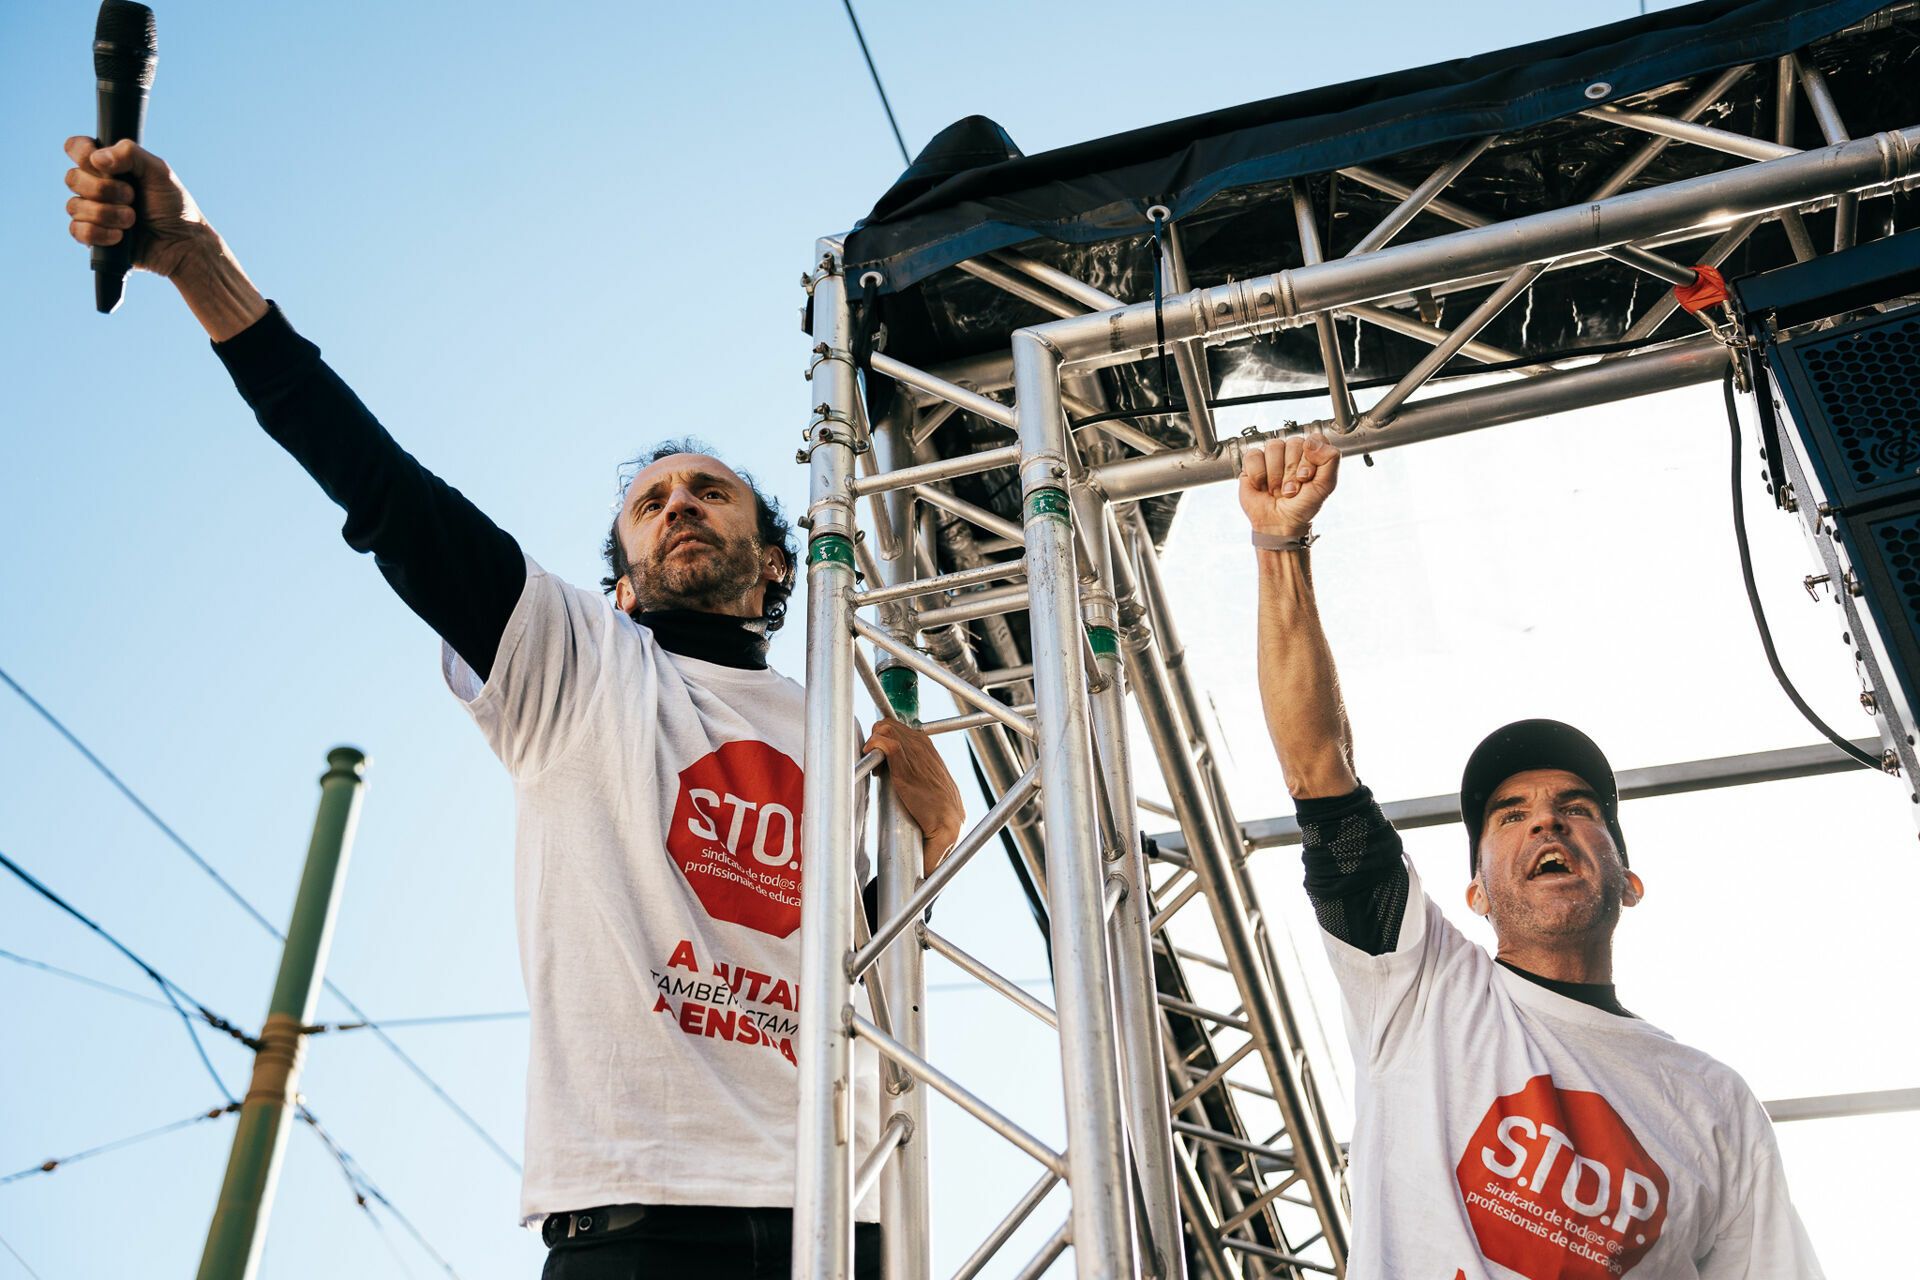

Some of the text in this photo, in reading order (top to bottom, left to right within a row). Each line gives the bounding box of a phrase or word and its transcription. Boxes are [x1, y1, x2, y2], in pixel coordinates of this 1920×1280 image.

[685, 861, 802, 907] profissionais de educa
[746, 868, 758, 881] de
[759, 872, 796, 890] tod@s
[667, 940, 699, 973] A
[1466, 1191, 1548, 1238] profissionais
[1549, 1230, 1568, 1247] de
[1484, 1181, 1624, 1255] sindicato de tod@s @s
